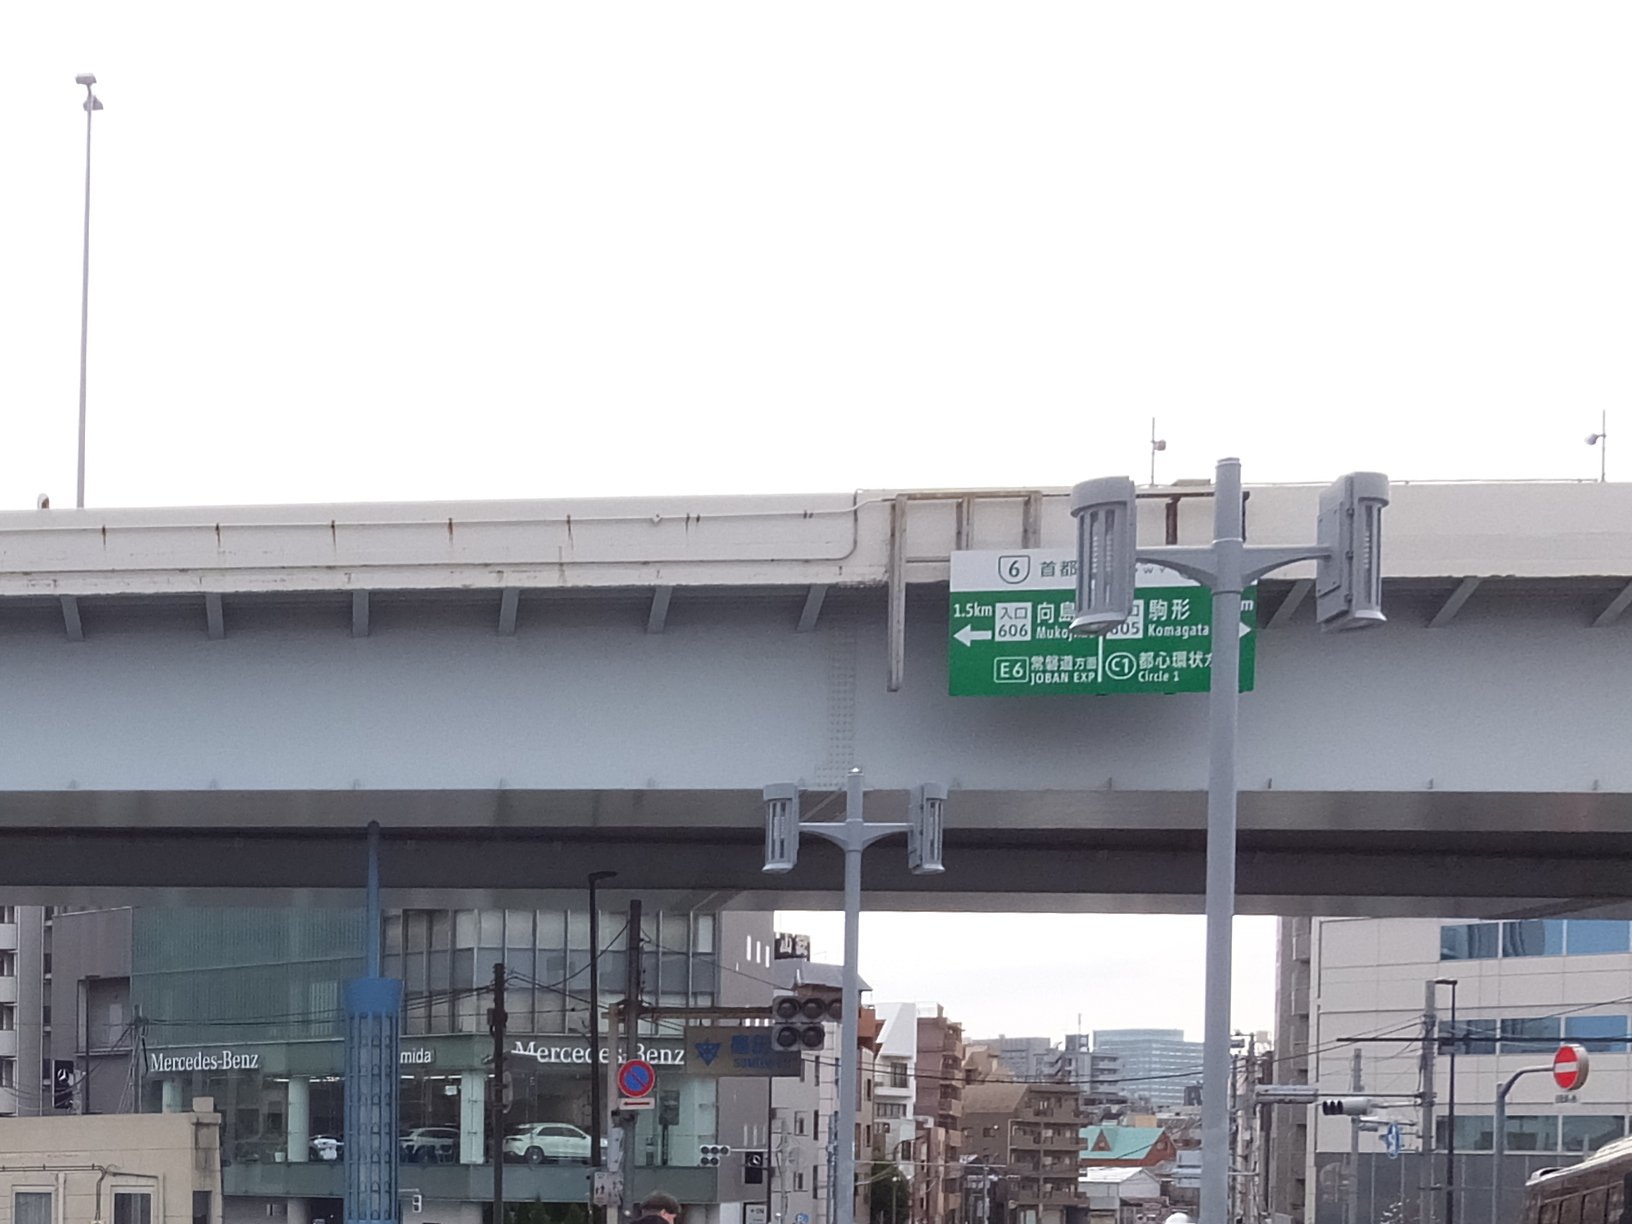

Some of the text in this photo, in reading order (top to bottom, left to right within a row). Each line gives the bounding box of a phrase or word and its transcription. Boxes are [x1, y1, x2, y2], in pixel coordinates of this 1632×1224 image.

[1008, 560, 1020, 578] 6
[953, 601, 993, 618] 1.5km
[1000, 606, 1028, 620] 入口
[1037, 601, 1076, 623] 向島
[1148, 598, 1190, 621] 駒形
[998, 624, 1028, 638] 606
[1036, 625, 1096, 642] Mukoj
[1147, 623, 1209, 639] Komagata
[1000, 661, 1024, 678] E6
[1110, 657, 1129, 674] C1
[1030, 672, 1095, 686] JOBAN EXP
[1138, 670, 1180, 682] Circle 1
[150, 1050, 259, 1072] Mercedes-Benz
[399, 1048, 432, 1064] mida
[512, 1041, 685, 1065] MerceesBenz
